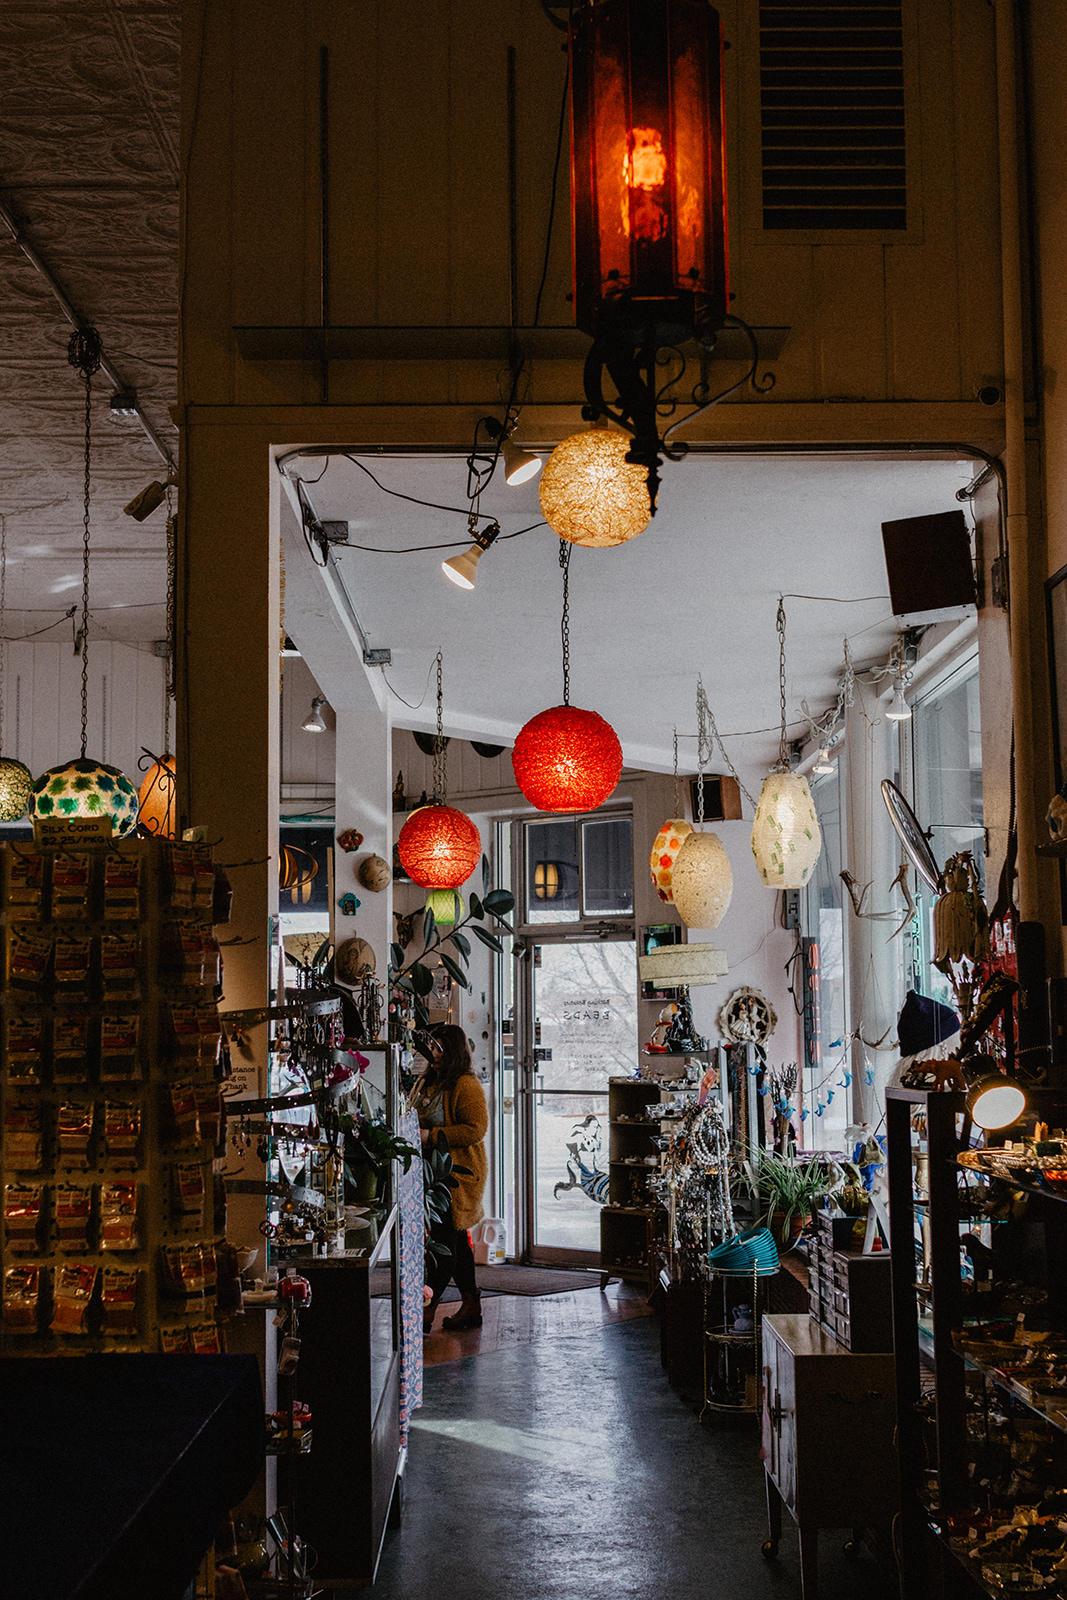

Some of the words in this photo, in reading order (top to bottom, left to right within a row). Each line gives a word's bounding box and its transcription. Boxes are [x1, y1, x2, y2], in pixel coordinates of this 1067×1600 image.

[42, 826, 64, 834] SILK
[68, 824, 99, 832] CORD
[42, 836, 105, 846] $2.25/PKG
